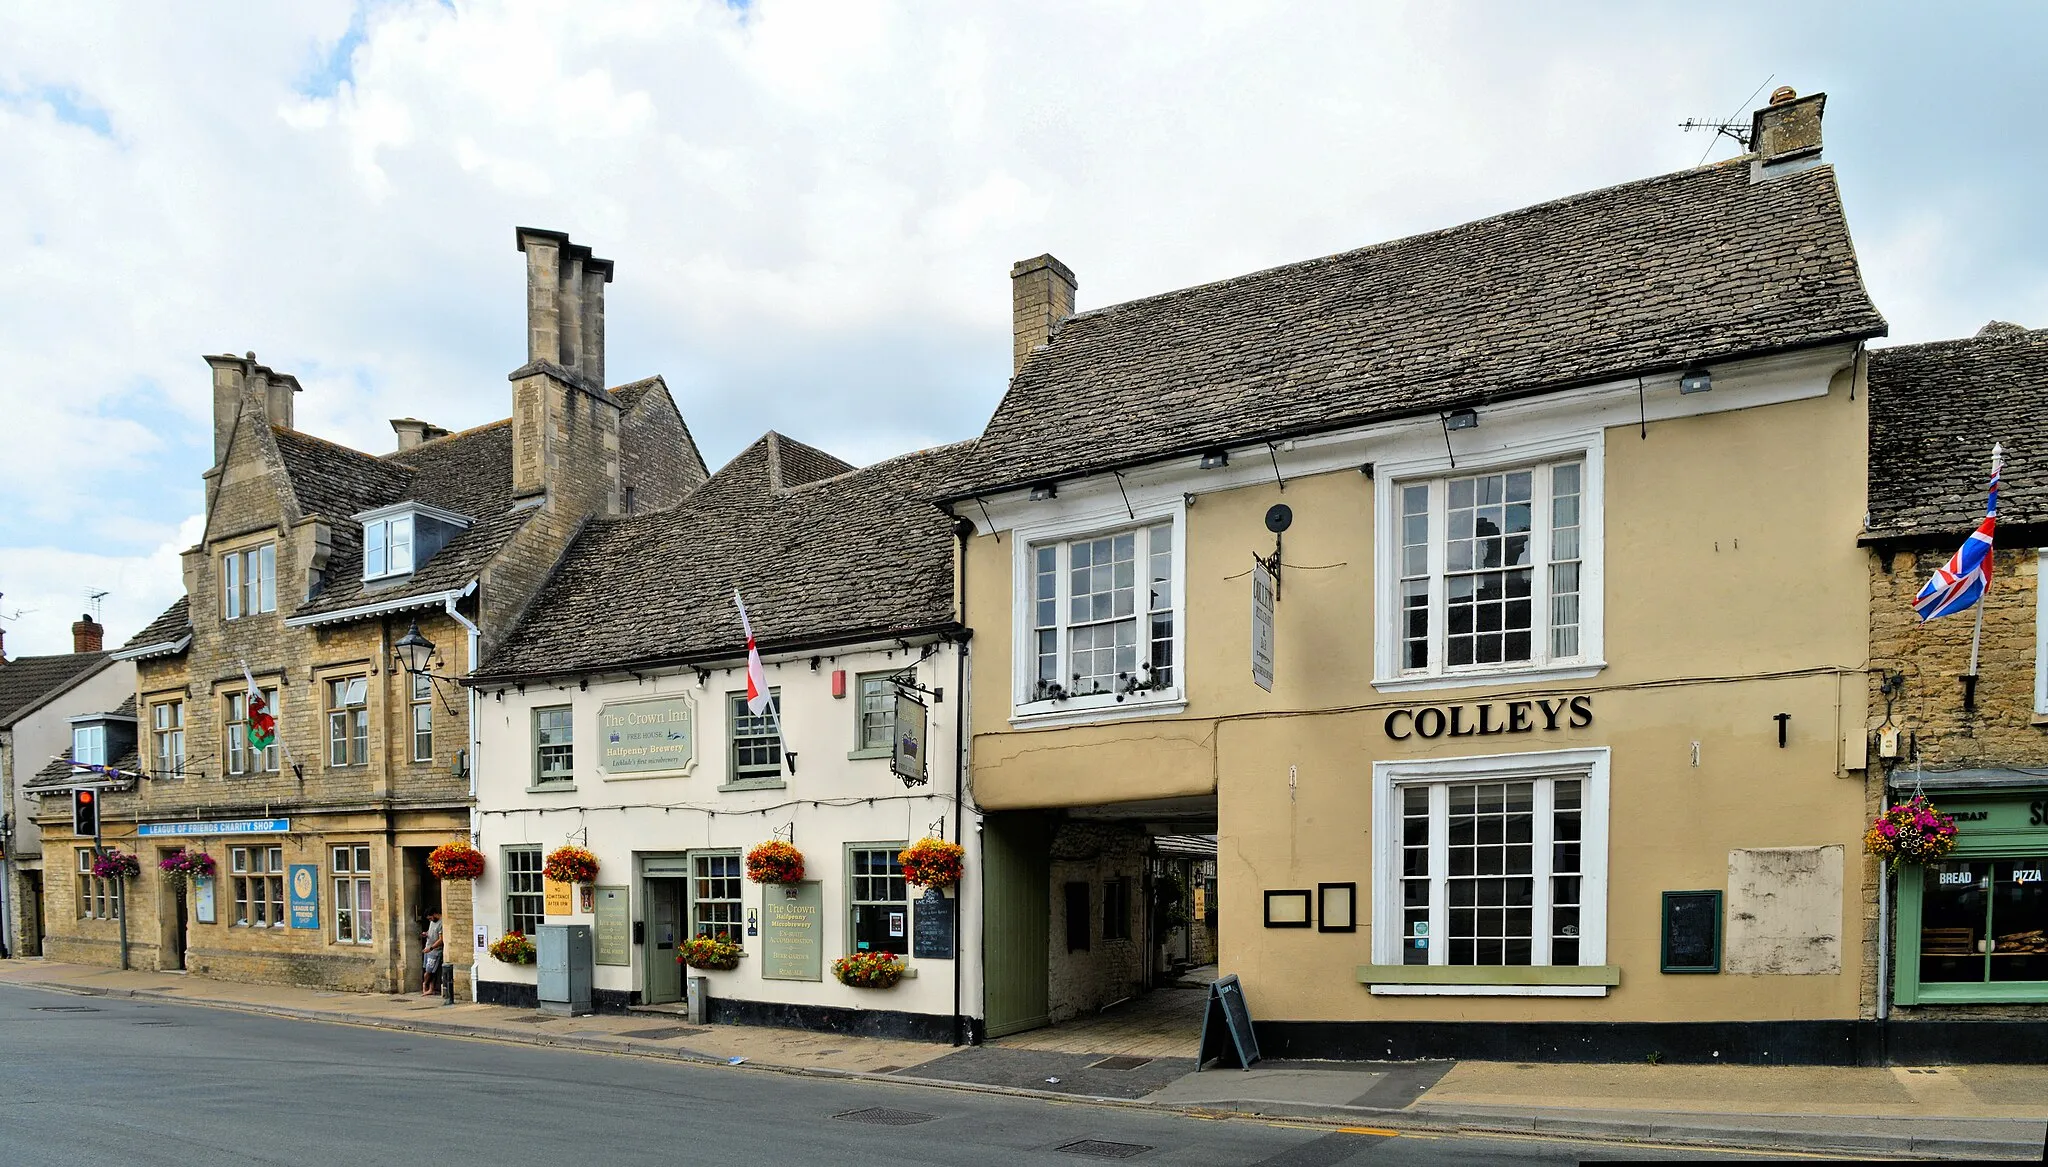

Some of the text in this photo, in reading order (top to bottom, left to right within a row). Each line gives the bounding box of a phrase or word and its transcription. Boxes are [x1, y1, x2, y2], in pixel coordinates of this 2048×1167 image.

[604, 709, 689, 727] The Crown Inn
[1384, 695, 1593, 741] COLLEYS
[627, 731, 663, 741] FREE HOUSE
[607, 744, 684, 758] Halfpenny Brewery
[150, 821, 274, 834] LEAGUE OF FRIENDS CHARITY SHOP
[1939, 871, 1972, 884] BREAD
[2012, 869, 2042, 882] PIZZA
[767, 903, 815, 914] The Crown
[775, 913, 807, 921] Halfpenny
[771, 920, 812, 929] Microbrewery
